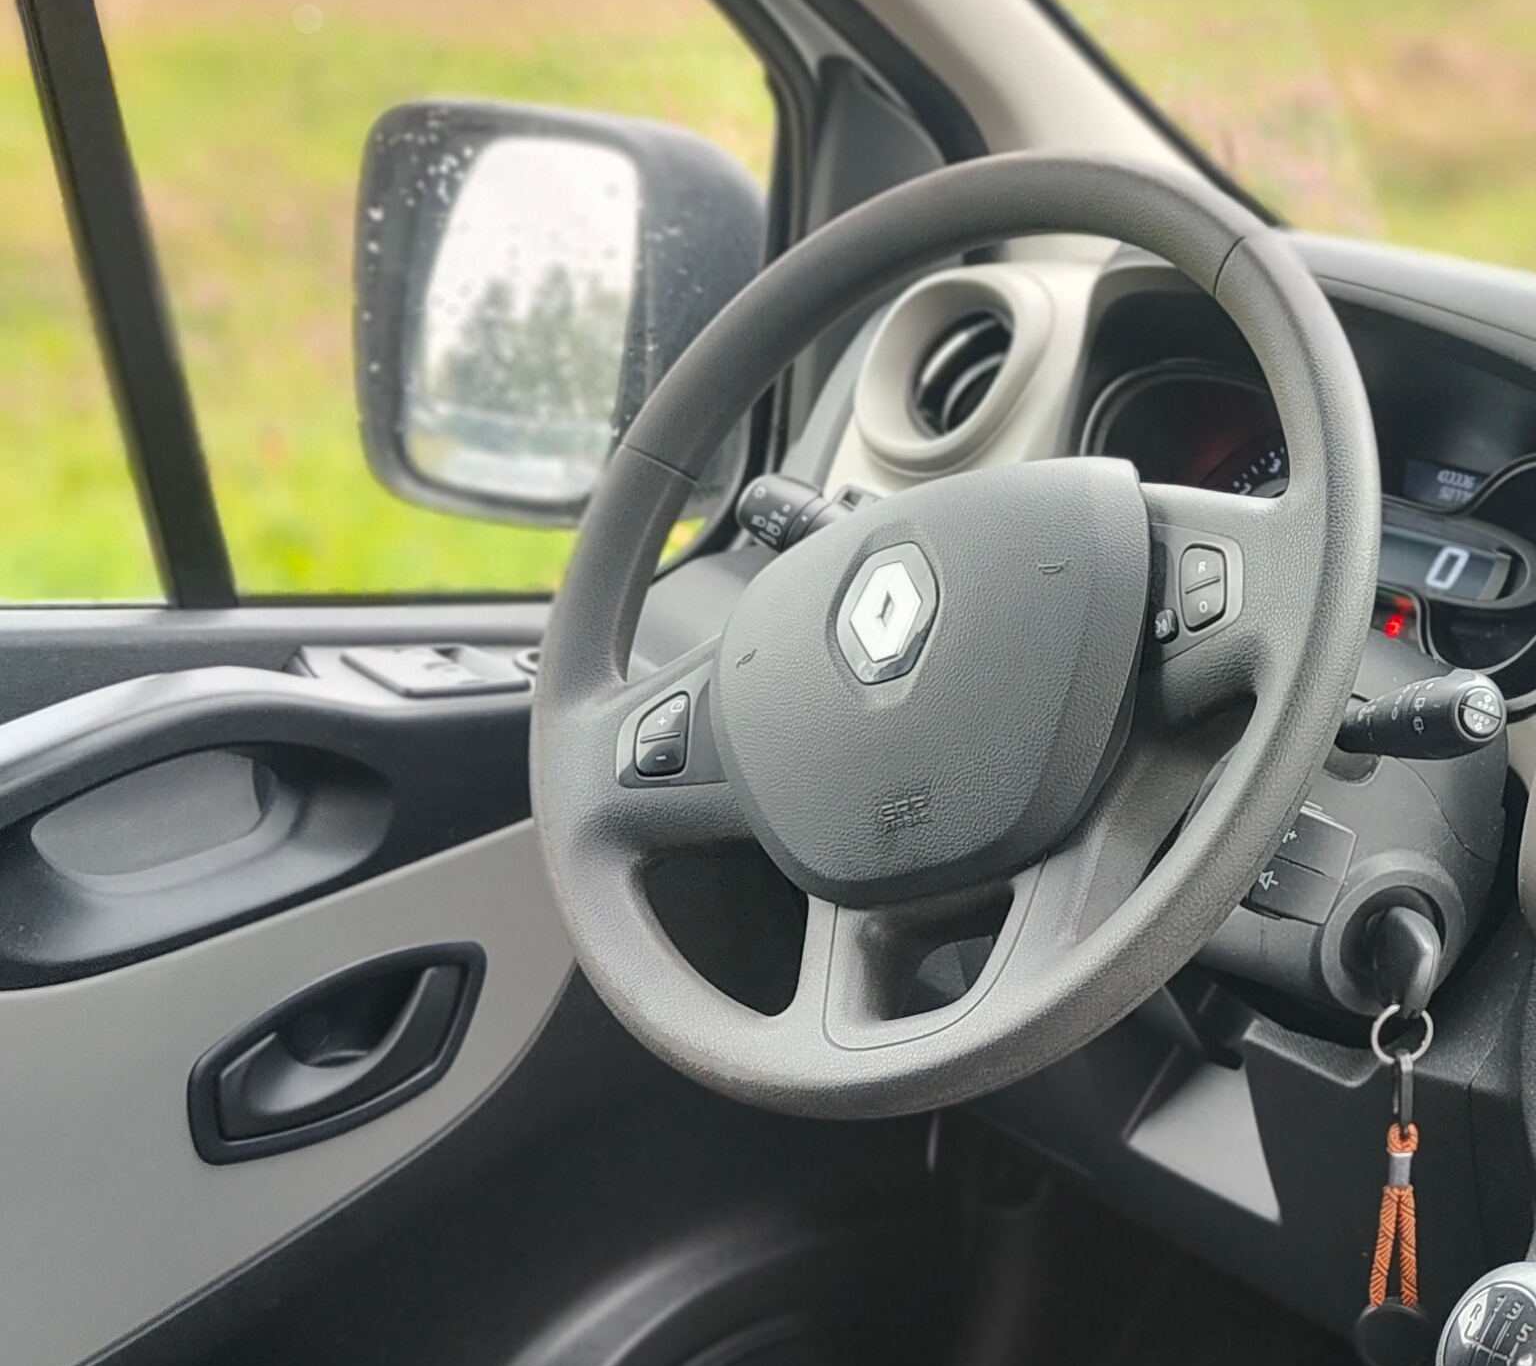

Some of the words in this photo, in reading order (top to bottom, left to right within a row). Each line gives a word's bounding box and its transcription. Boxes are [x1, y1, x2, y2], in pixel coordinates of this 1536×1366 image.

[1268, 458, 1281, 473] 3
[1198, 560, 1207, 573] R
[1426, 546, 1469, 590] 0
[1470, 1303, 1482, 1320] R
[1504, 1301, 1524, 1320] 3
[1516, 1323, 1535, 1343] 5
